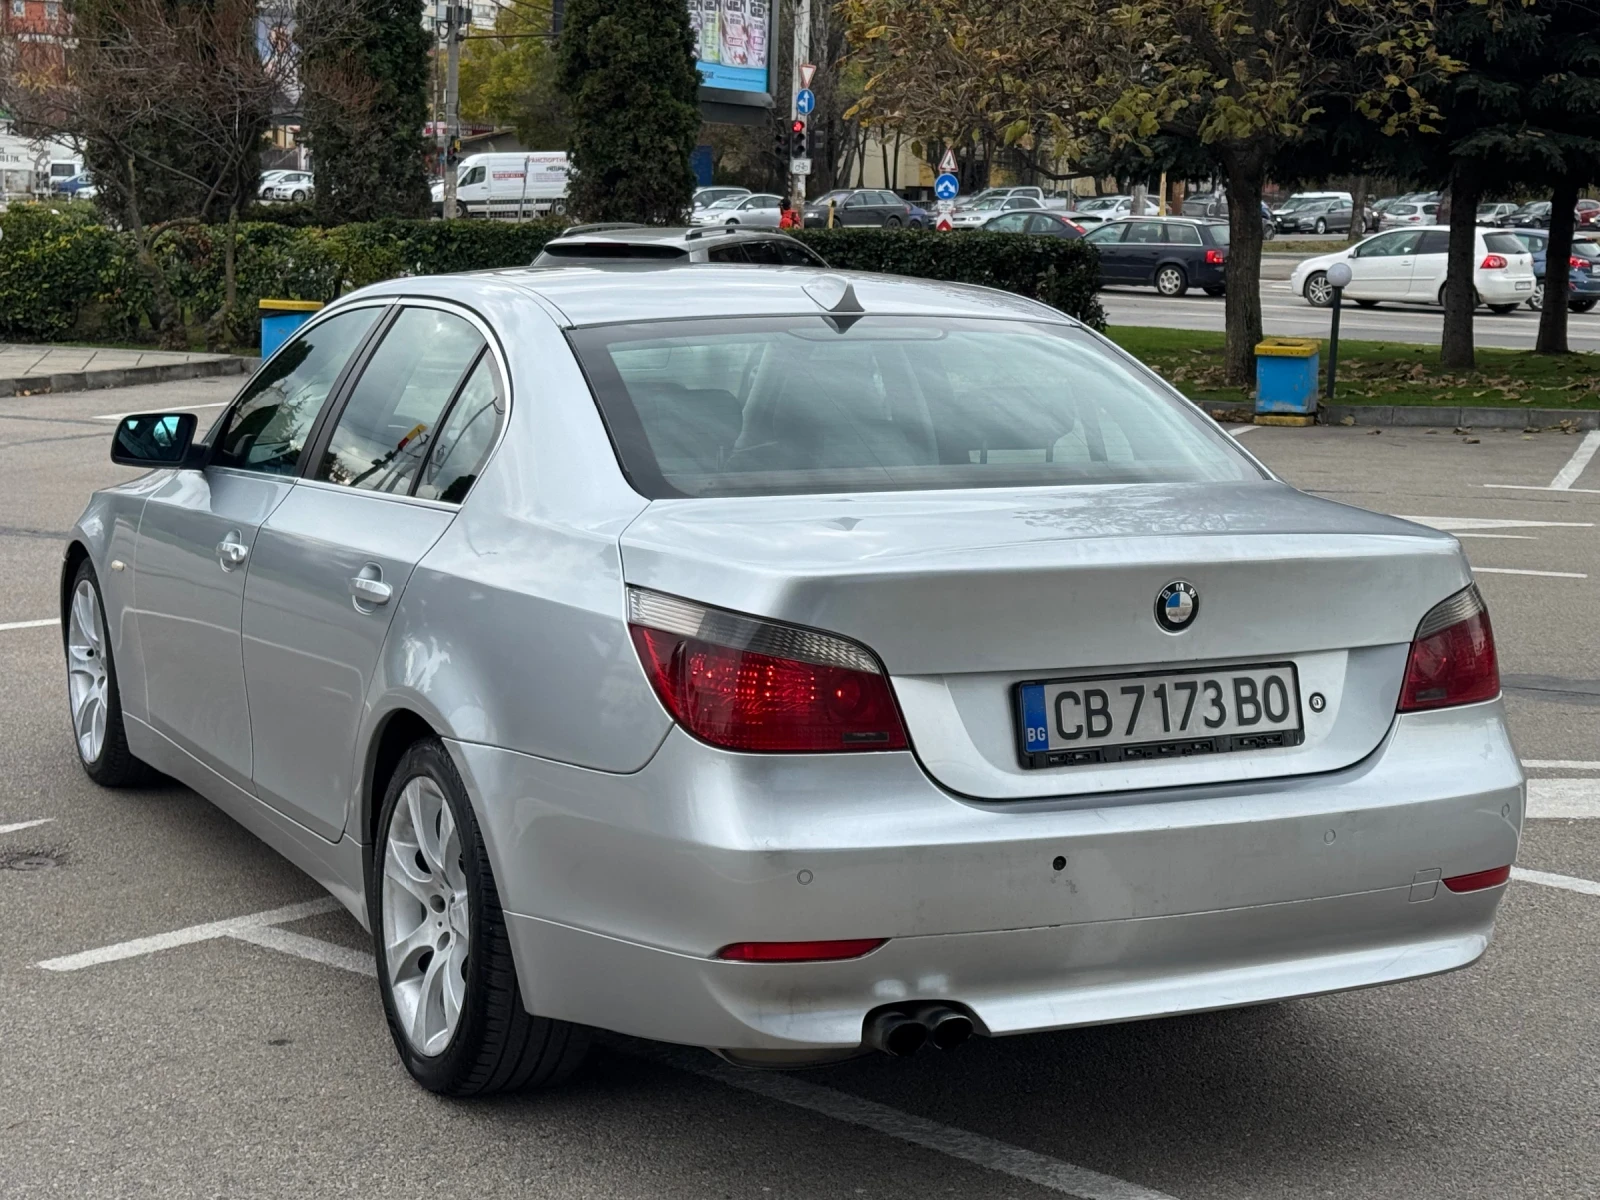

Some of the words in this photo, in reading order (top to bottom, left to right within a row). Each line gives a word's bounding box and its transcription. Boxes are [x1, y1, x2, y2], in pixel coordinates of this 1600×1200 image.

[1162, 583, 1197, 600] BMW
[1054, 688, 1114, 741] CB
[1120, 679, 1227, 736] 7173
[1027, 726, 1047, 743] BG
